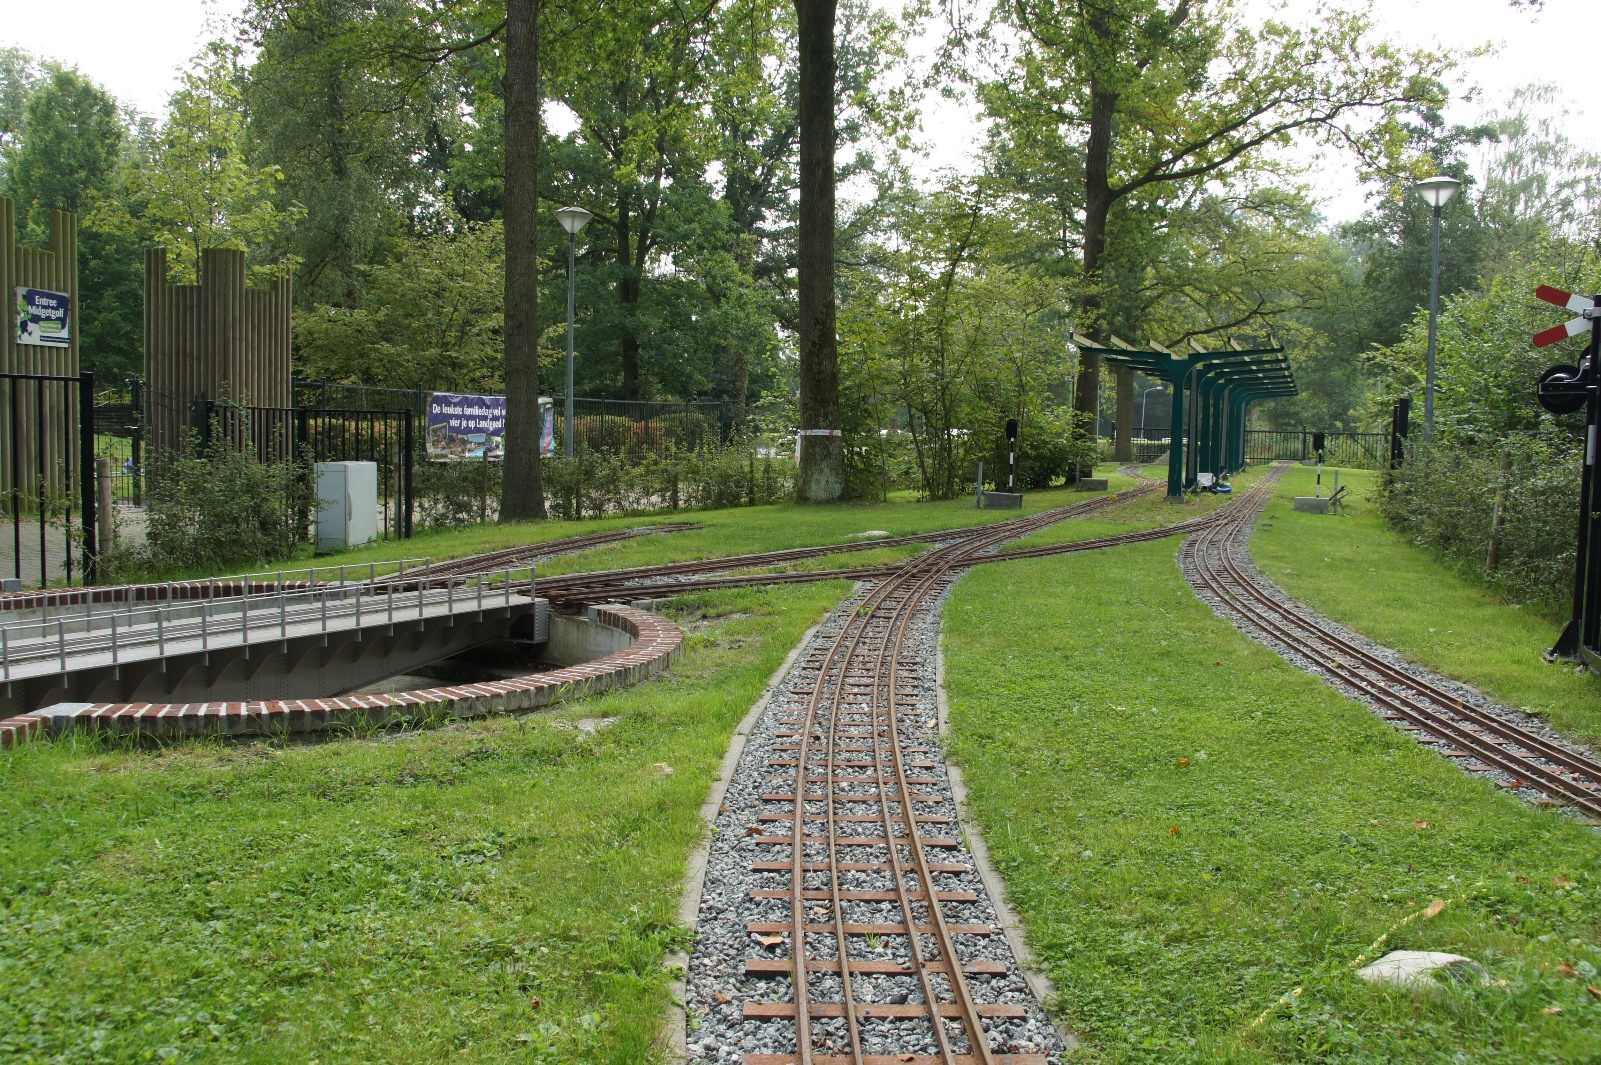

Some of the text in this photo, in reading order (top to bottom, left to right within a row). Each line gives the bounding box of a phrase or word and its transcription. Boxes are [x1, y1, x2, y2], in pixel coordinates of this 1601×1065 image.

[35, 296, 57, 307] Entree
[28, 305, 64, 319] Midgetgolf
[432, 404, 441, 414] De
[442, 404, 462, 415] leukste
[463, 405, 492, 418] familiedag
[492, 407, 501, 416] vol
[449, 418, 460, 427] vier
[461, 417, 467, 429] je
[468, 420, 475, 430] op
[476, 418, 501, 430] Landgoed
